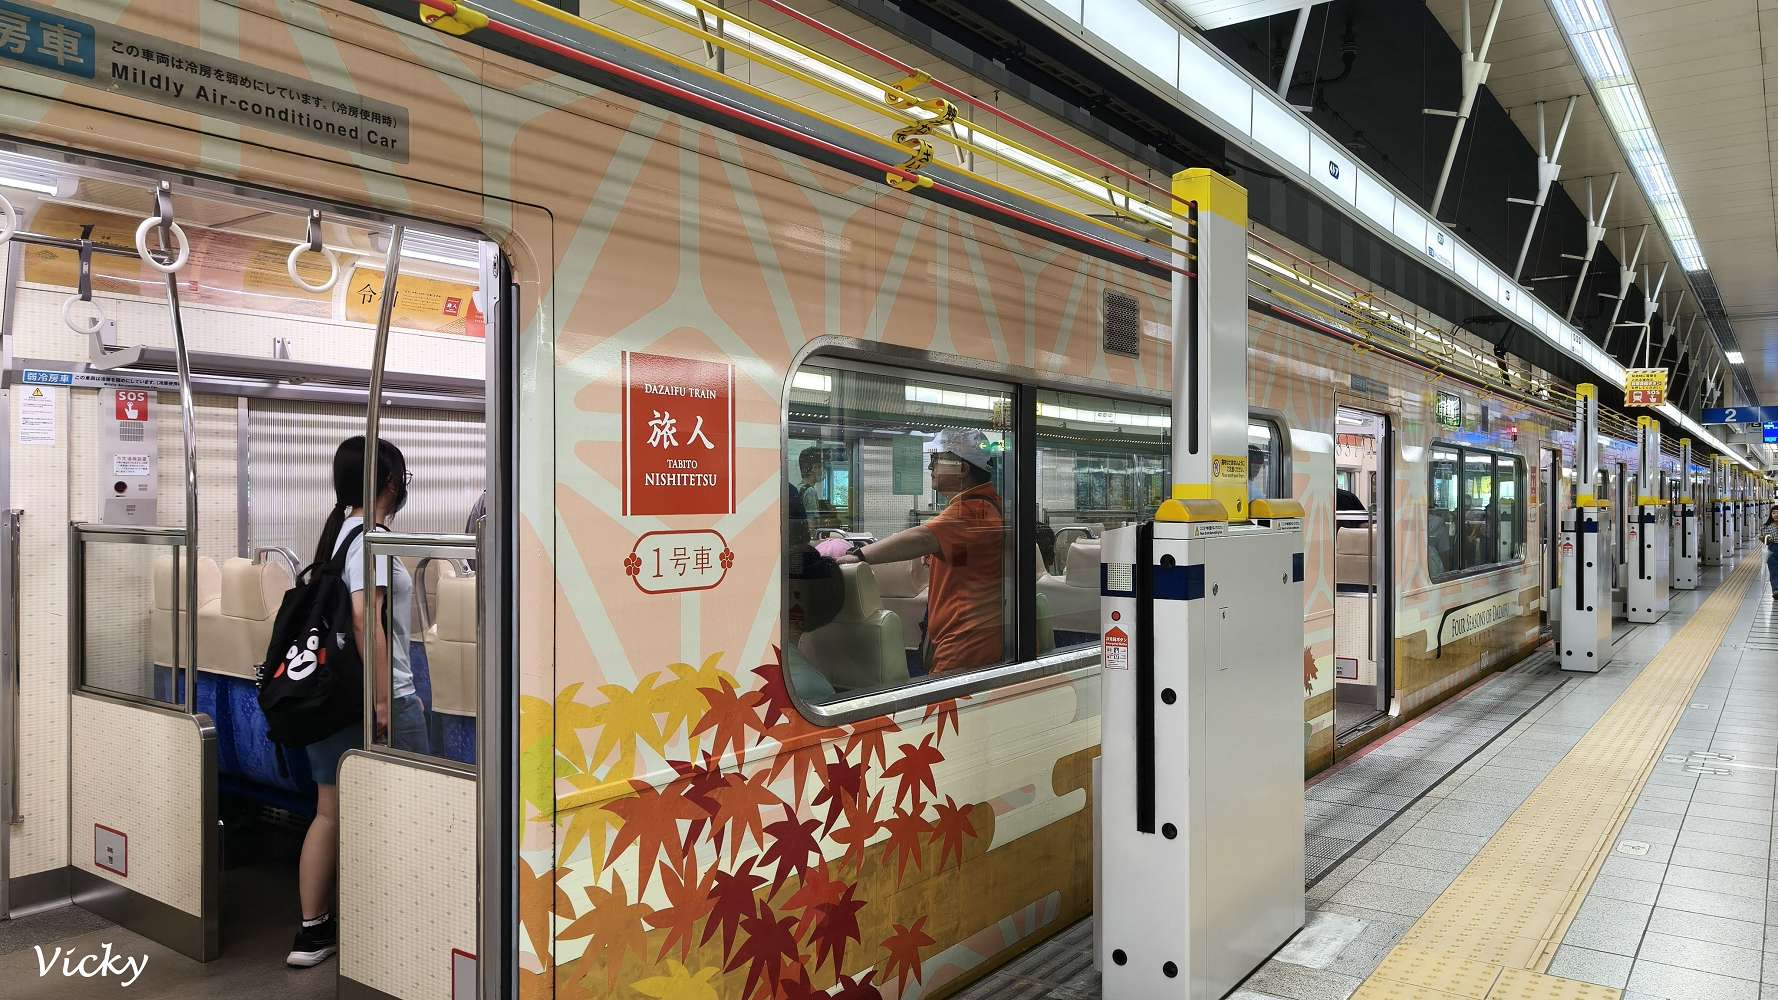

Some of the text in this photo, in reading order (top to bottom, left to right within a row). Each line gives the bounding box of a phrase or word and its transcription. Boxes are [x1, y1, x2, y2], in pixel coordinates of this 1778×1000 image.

[112, 62, 398, 149] Mildly Air-conditioned Car
[118, 391, 145, 402] SOS
[644, 383, 717, 400] DAZAIFU TRAIN
[1724, 408, 1737, 422] 2
[646, 409, 716, 450] 旅人
[666, 459, 698, 469] TABITO
[644, 472, 718, 487] NISHITETSU
[652, 545, 713, 578] 1号車
